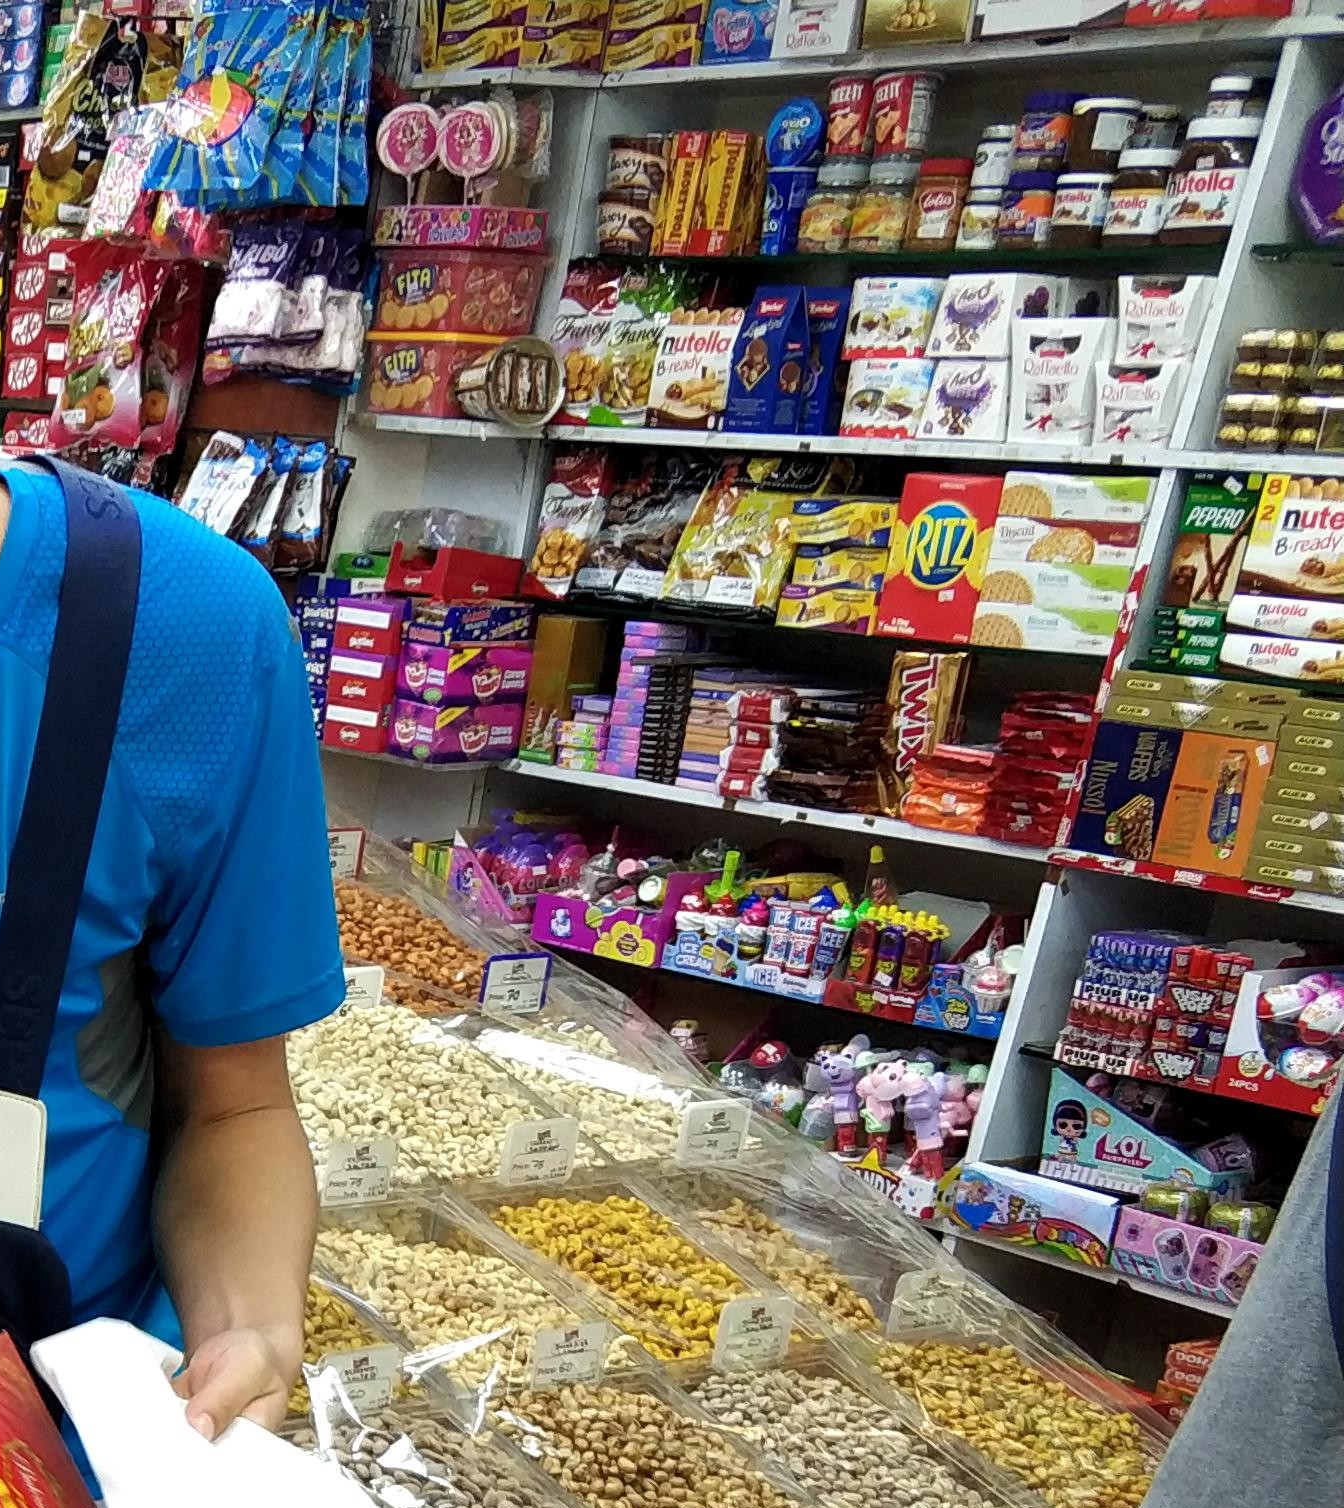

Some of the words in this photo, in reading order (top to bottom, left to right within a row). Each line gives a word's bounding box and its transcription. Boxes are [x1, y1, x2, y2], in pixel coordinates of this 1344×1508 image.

[1167, 171, 1236, 196] nutella
[551, 315, 611, 346] Fancy
[609, 321, 666, 351] Fancy
[662, 330, 733, 353] nutella
[1185, 505, 1245, 530] PEPERO
[1280, 506, 1344, 532] nute
[907, 514, 978, 578] RITZ
[896, 652, 941, 773] TWIX
